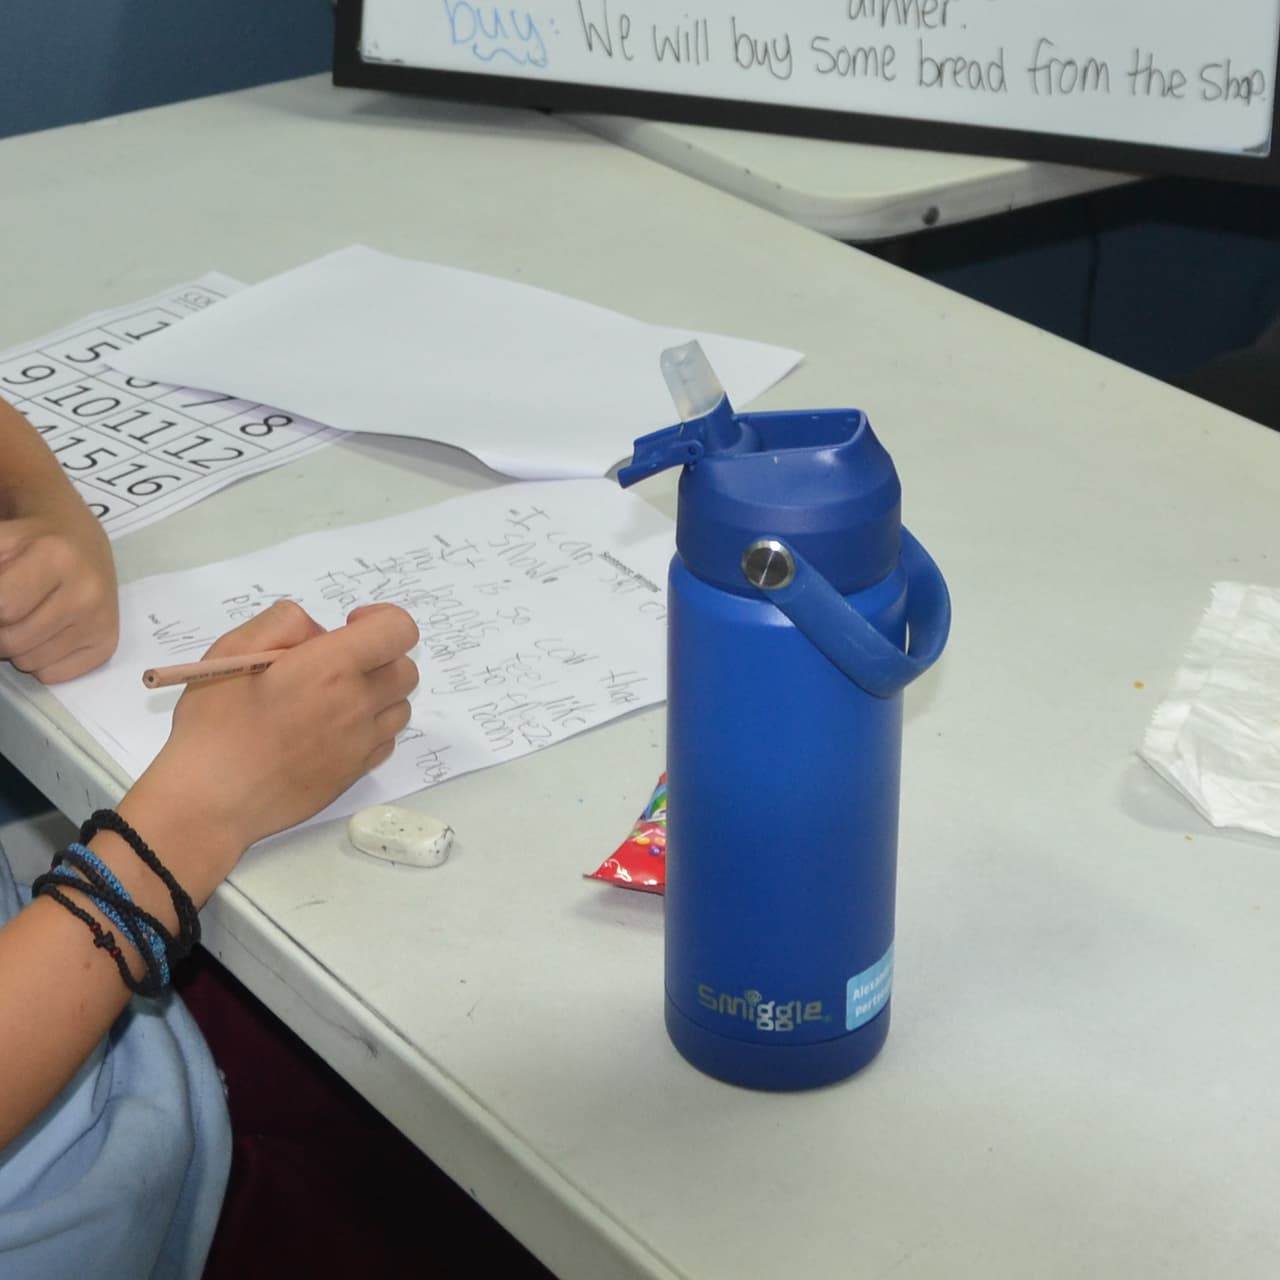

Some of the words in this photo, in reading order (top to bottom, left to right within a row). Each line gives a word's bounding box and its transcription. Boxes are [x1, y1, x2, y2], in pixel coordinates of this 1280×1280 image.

[652, 12, 711, 67] will
[730, 16, 793, 81] buy
[919, 37, 1008, 96] bread
[1028, 37, 1111, 96] from
[1126, 47, 1187, 100] the
[65, 341, 121, 364] 5
[1, 364, 57, 386] 9
[43, 384, 121, 418] 10
[101, 408, 177, 445] 11
[238, 413, 294, 438] 8
[53, 435, 119, 473] 15
[162, 434, 245, 470] 12
[95, 462, 183, 497] 16
[698, 983, 824, 1032] Smiggle
